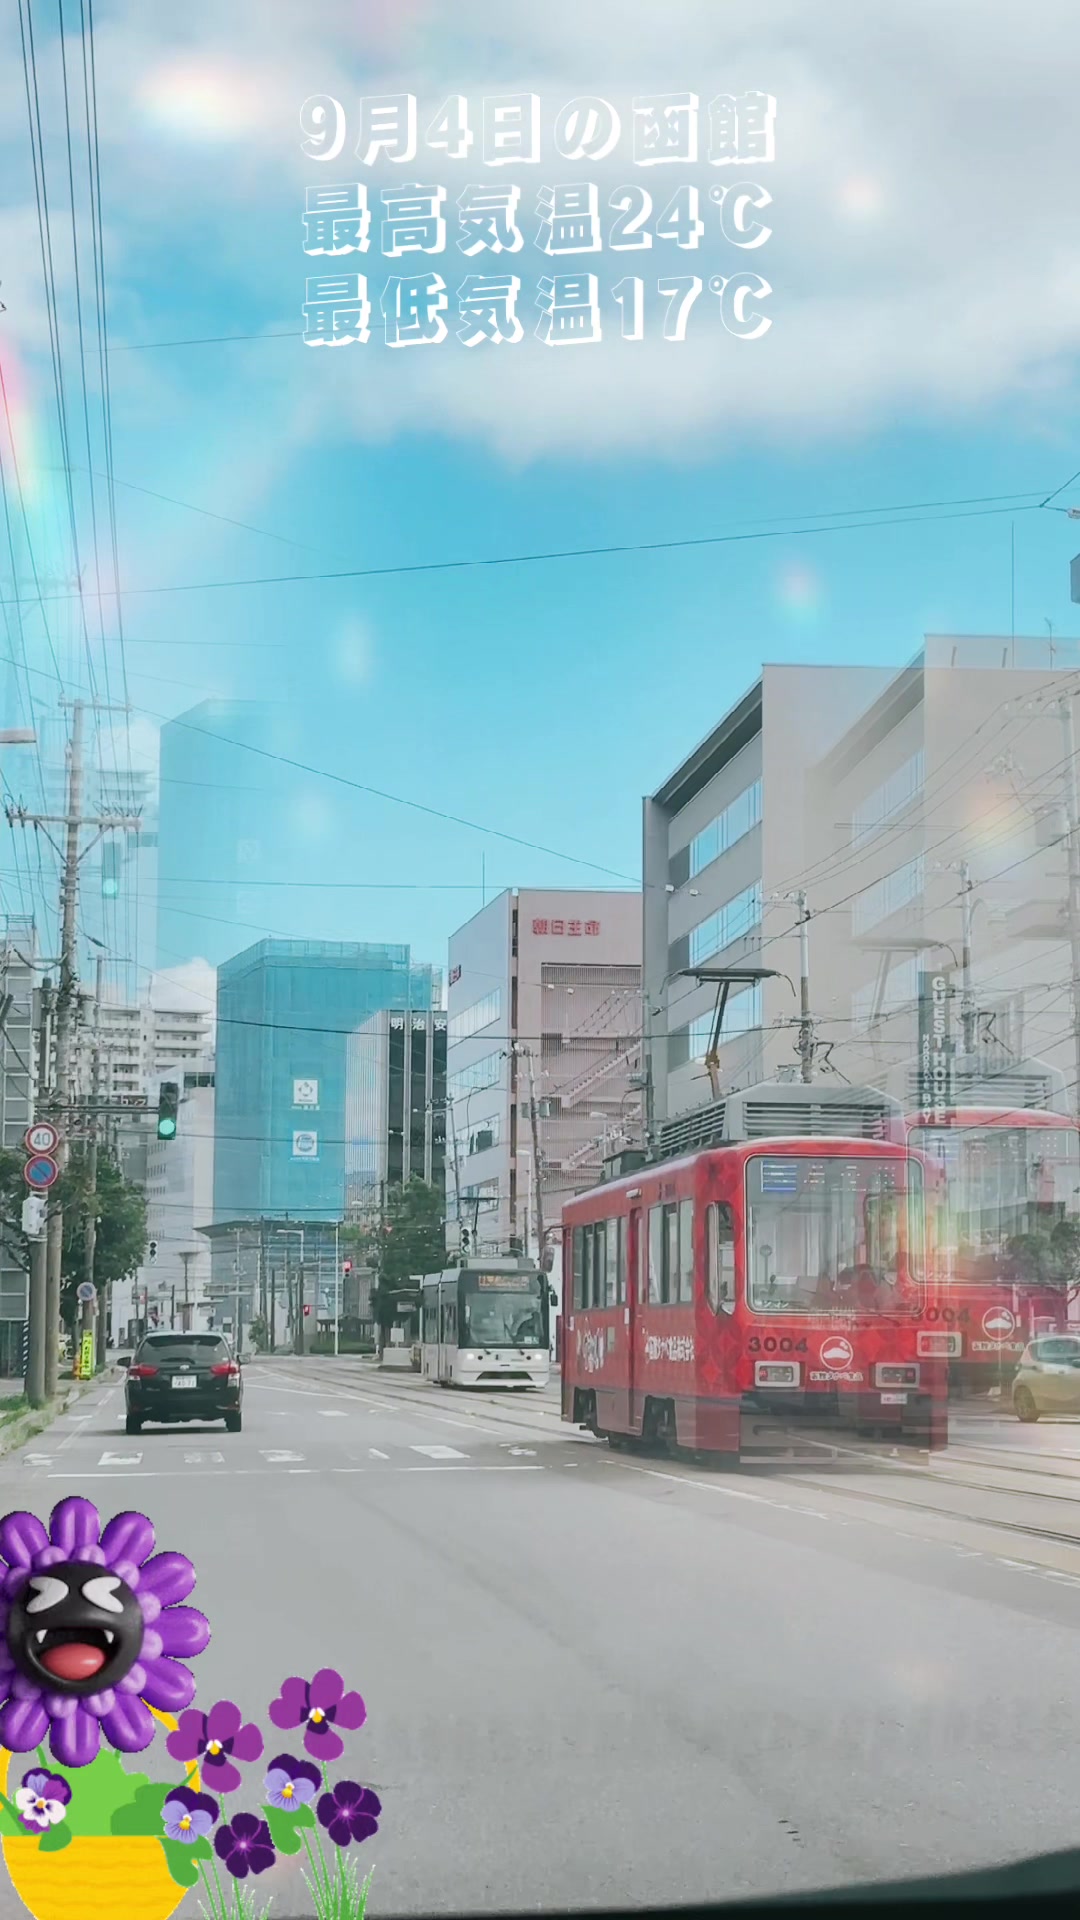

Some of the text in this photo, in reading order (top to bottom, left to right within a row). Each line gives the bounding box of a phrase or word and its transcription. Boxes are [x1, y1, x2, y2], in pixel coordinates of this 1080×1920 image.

[390, 1017, 447, 1031] 明治安
[931, 976, 947, 1124] GUEST HOUSE
[33, 1132, 51, 1146] 40
[748, 1337, 808, 1352] 3004
